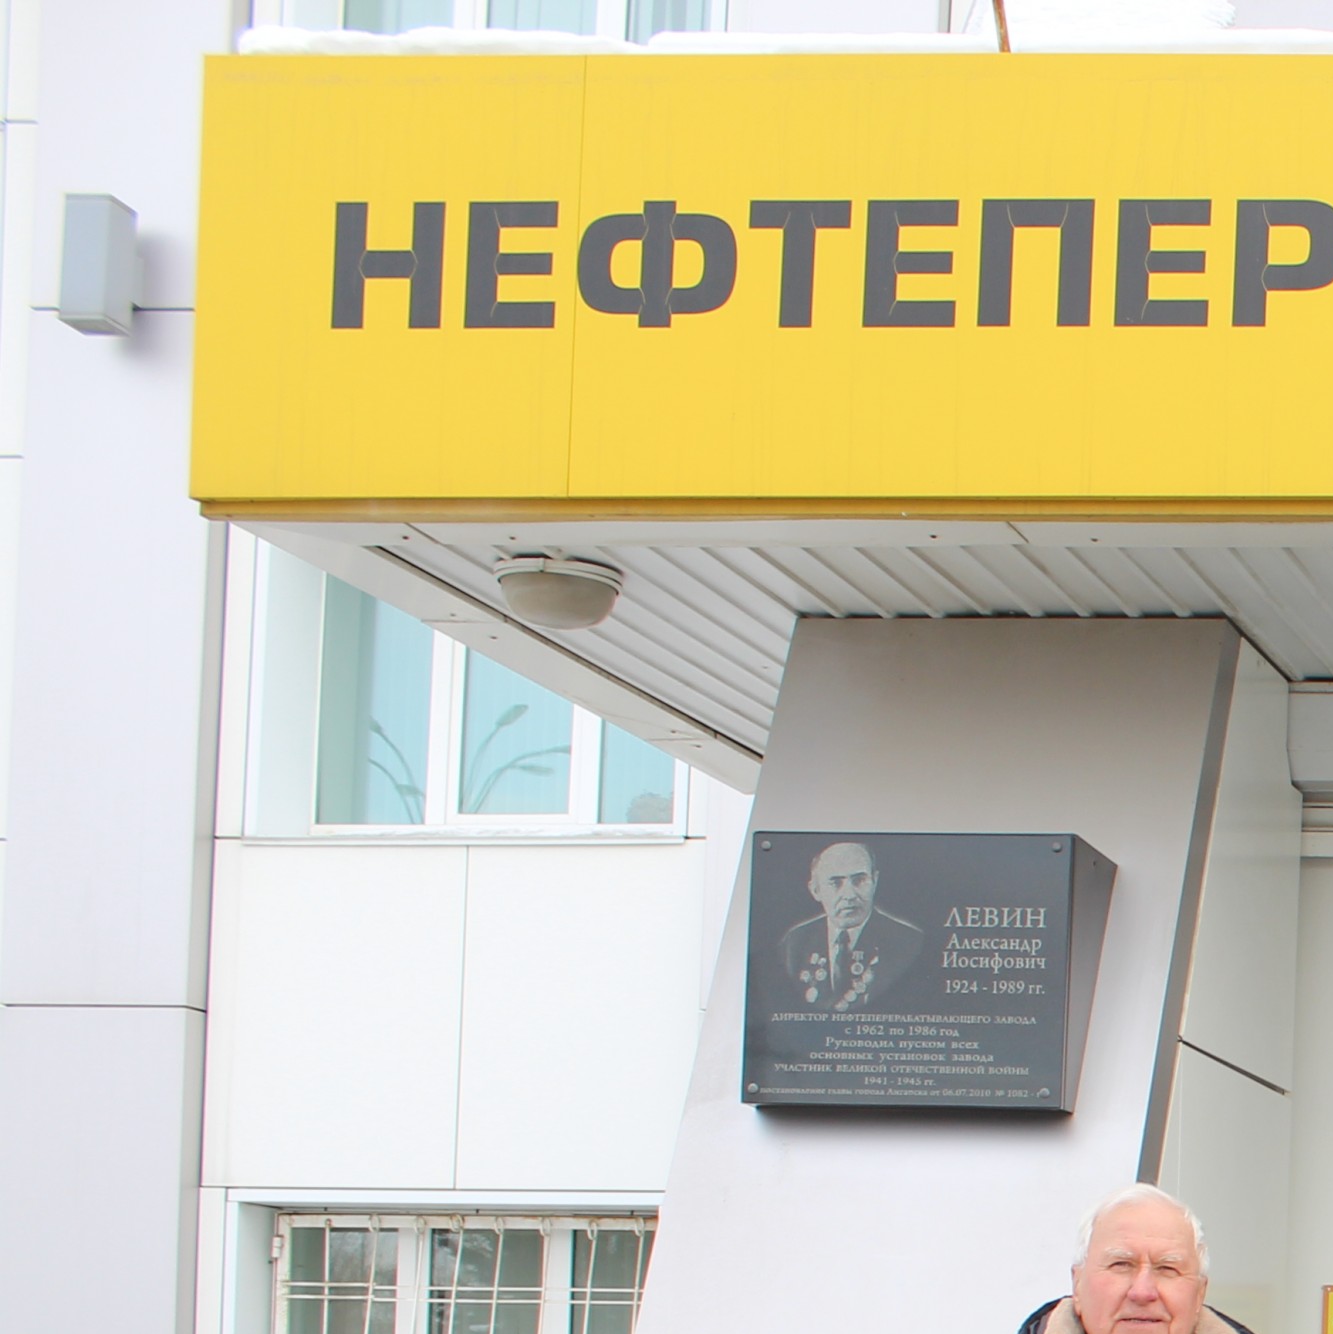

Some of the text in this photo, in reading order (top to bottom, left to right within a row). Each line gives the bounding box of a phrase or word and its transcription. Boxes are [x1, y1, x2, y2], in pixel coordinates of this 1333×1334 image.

[944, 906, 1047, 927] ЛЕВИН
[946, 933, 1042, 955] Александр
[942, 951, 1046, 974] Иосифович
[945, 980, 978, 994] 1924
[992, 980, 1025, 994] 1989
[1028, 984, 1046, 994] гг.
[771, 1012, 1037, 1025] ДИРЕКТОР НЕФТЕПЕРЕРАБАТЫВАЮЩЕГО ЗАВОДА
[844, 1025, 960, 1037] с 1962 по 1986 год
[825, 1036, 980, 1050] Руководил пуском всех
[809, 1051, 994, 1063] основных установок завода
[773, 1063, 1030, 1076] УЧАСТНИК ВЕЛИКОЙ ОТЕЧЕСТВЕННОЙ ВОЙНЫ
[863, 1076, 888, 1085] 1941
[896, 1076, 922, 1086] 1945
